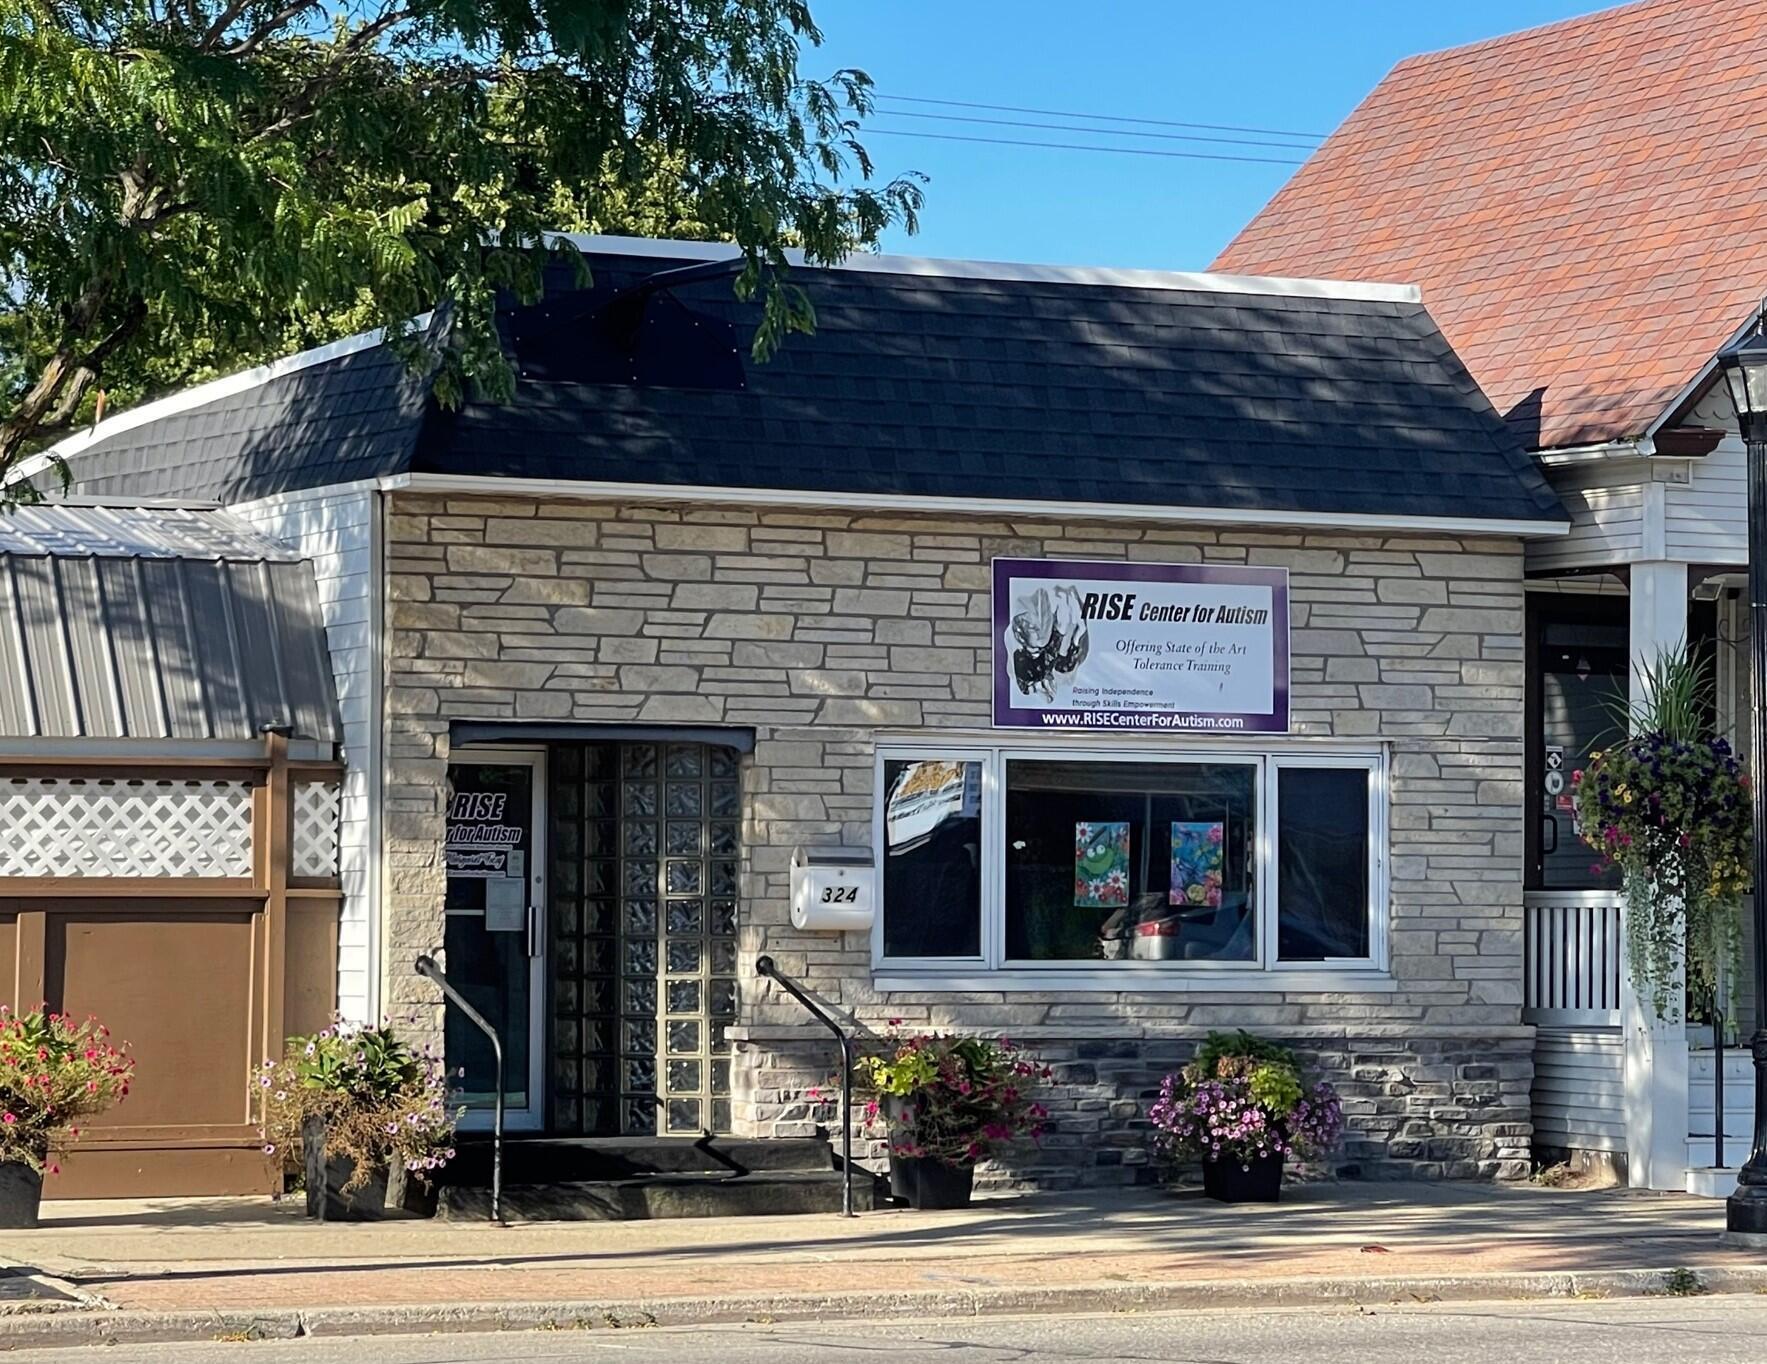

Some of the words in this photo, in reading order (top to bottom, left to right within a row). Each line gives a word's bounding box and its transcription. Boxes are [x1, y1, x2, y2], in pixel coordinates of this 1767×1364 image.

[1081, 593, 1136, 620] RISE
[1139, 602, 1190, 622] Center
[1192, 604, 1215, 623] for
[1216, 605, 1268, 625] Autism
[1116, 639, 1162, 655] Offering
[1165, 642, 1192, 655] State
[1195, 642, 1208, 656] of
[1209, 642, 1225, 655] the
[1227, 643, 1247, 655] Art
[1133, 658, 1185, 671] Tolerance
[1186, 660, 1231, 675] Training
[1072, 686, 1099, 696] Raising
[1101, 687, 1153, 697] Independence
[1072, 699, 1100, 708] through
[1102, 699, 1121, 708] Skills
[1123, 700, 1175, 709] Empowerment
[1042, 712, 1243, 728] www.RISECenterForAutism.com
[452, 793, 506, 820] RISE
[454, 824, 475, 843] for
[473, 824, 522, 843] Autism
[822, 887, 859, 903] 324
